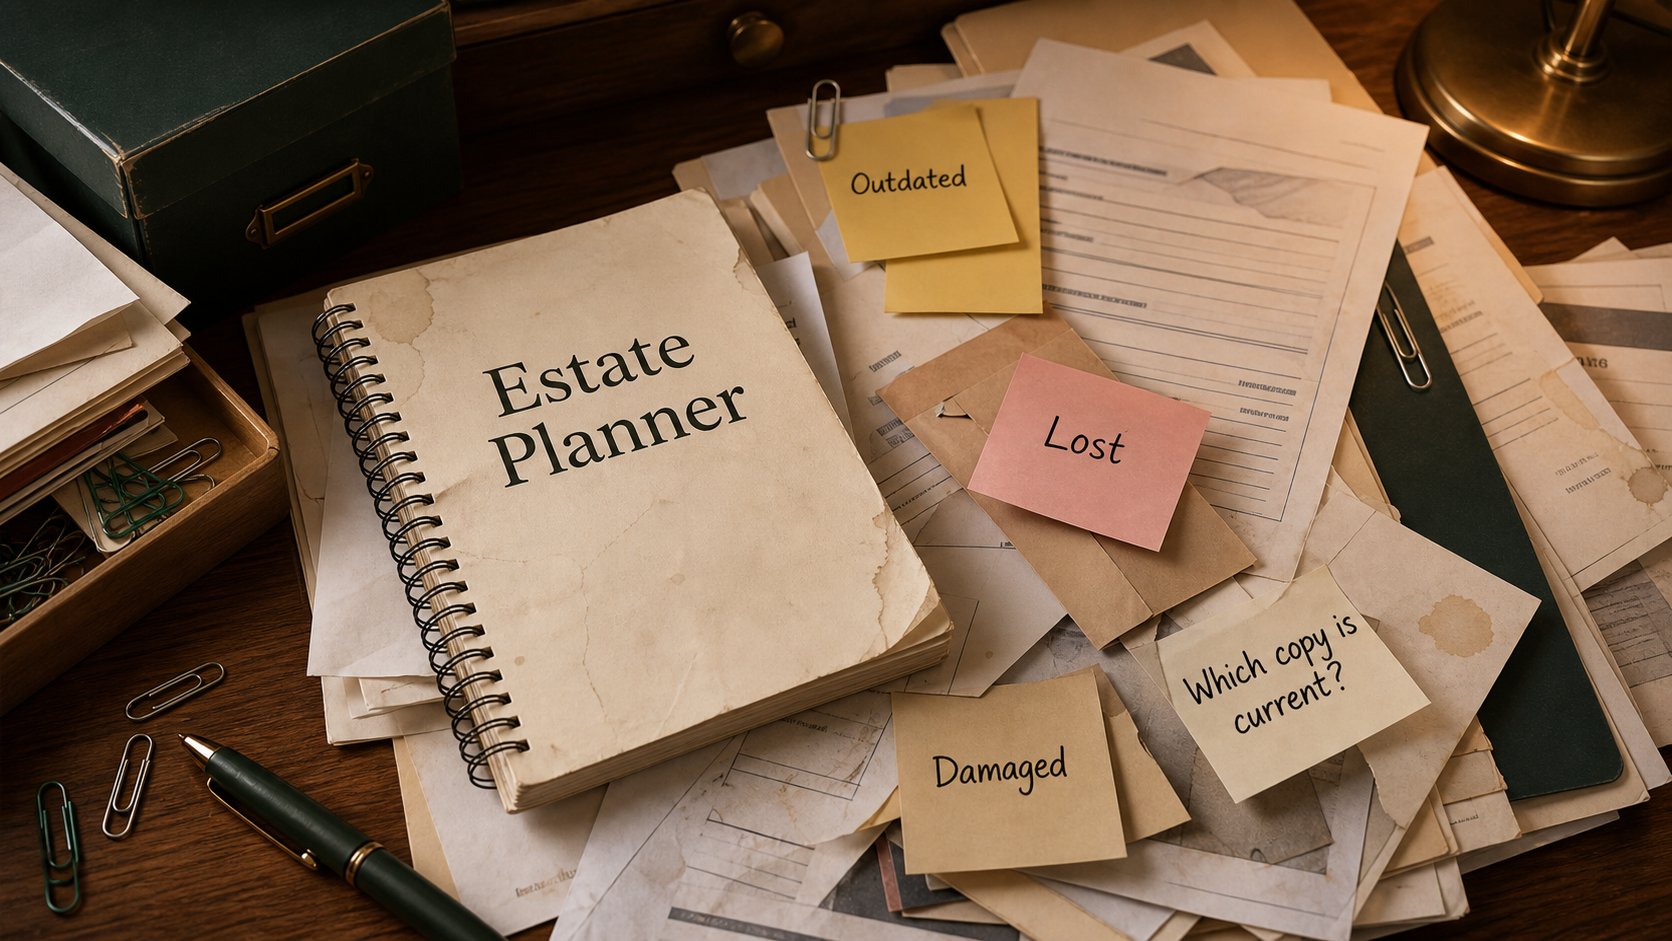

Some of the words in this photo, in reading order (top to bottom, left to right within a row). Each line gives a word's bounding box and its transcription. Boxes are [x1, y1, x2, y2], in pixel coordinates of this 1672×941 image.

[850, 163, 967, 195] Outdated
[482, 335, 695, 418] Estate
[487, 385, 747, 488] Planner
[1044, 415, 1126, 465] Lost
[1182, 650, 1268, 705] Which
[1275, 628, 1334, 667] copy
[1333, 614, 1358, 638] is
[1233, 660, 1346, 734] current?
[932, 745, 1068, 796] Damaged
